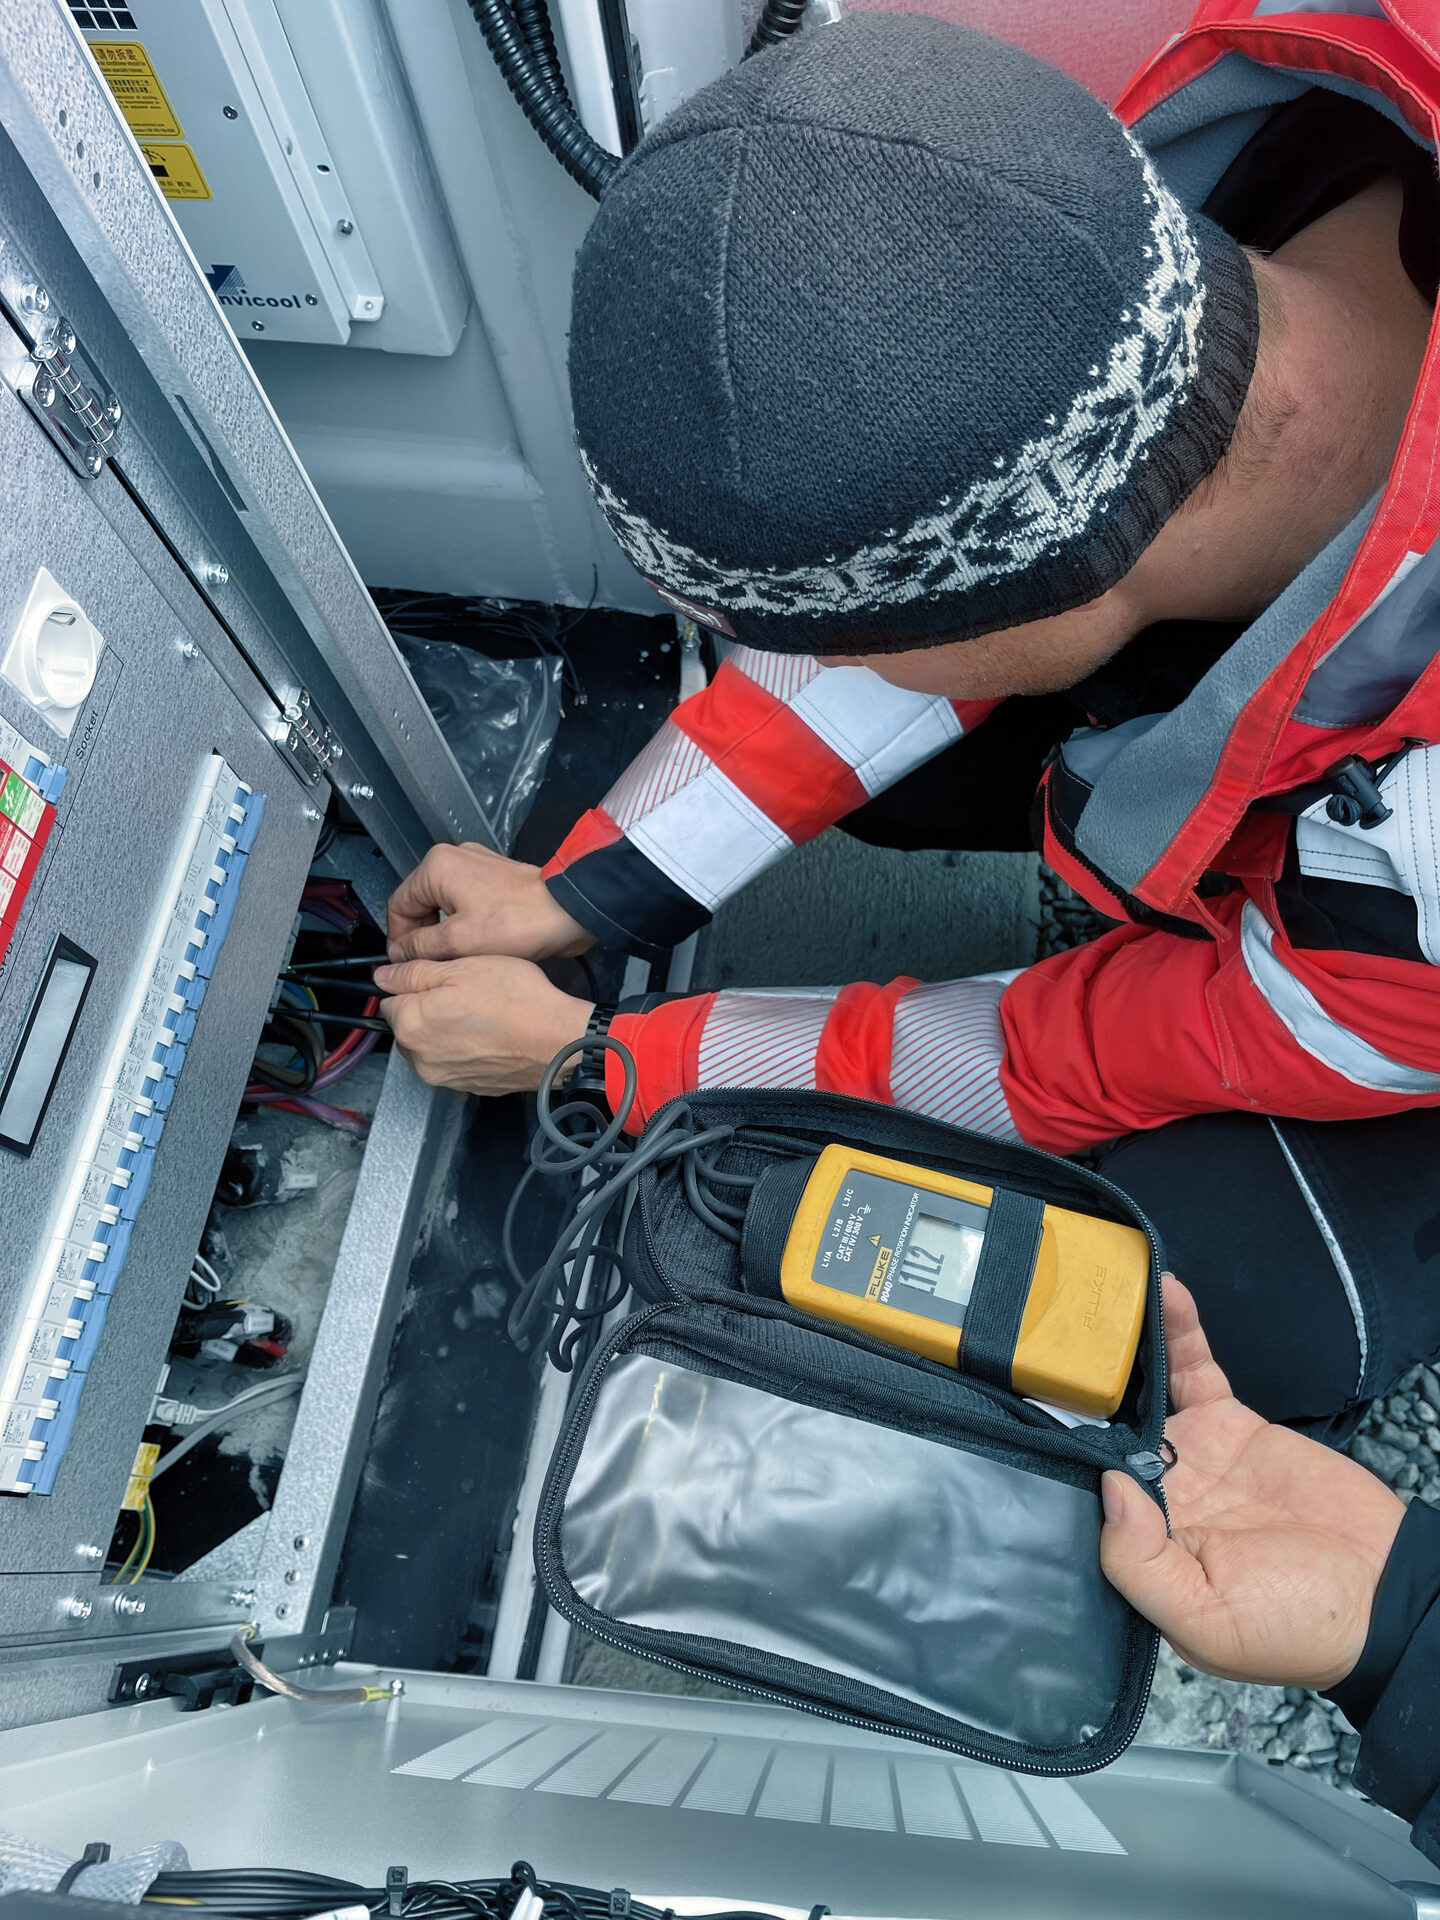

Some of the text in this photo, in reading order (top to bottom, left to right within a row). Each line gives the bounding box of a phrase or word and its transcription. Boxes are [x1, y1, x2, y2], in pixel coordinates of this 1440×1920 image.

[91, 48, 137, 61] 请勿拆装
[218, 289, 302, 309] nvicool
[76, 710, 98, 760] Socket
[842, 1188, 854, 1207] L3/C
[832, 1218, 844, 1237] L2/B
[835, 1244, 846, 1260] CAT
[843, 1246, 854, 1262] CAT
[880, 1192, 920, 1303] 9040 PHASE ROTATION INDICATOR
[821, 1251, 833, 1267] L1/A
[869, 1250, 890, 1297] FLUKE
[1083, 1264, 1107, 1330] FLUKE
